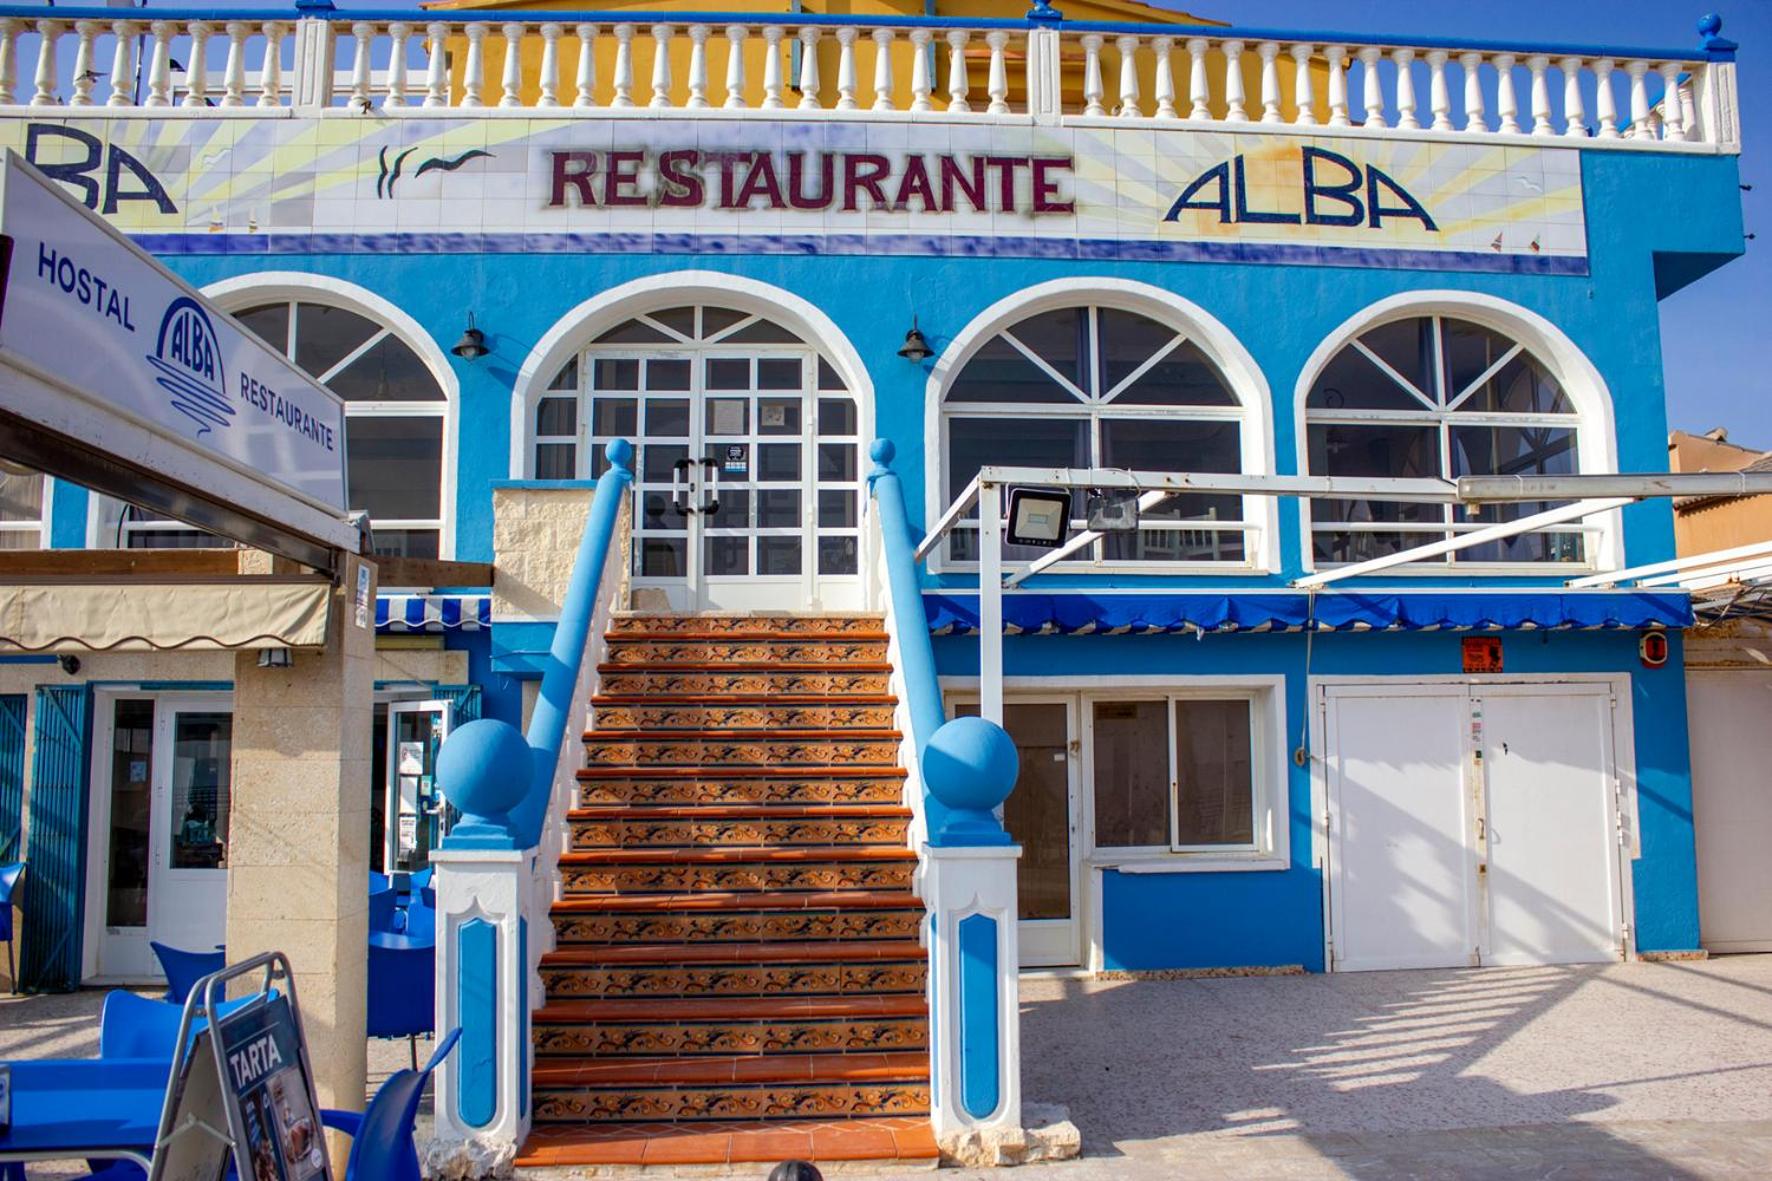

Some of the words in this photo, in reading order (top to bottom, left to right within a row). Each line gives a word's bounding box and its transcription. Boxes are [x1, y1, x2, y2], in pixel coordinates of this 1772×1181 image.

[548, 150, 1076, 216] RESTAURANTE
[1162, 145, 1440, 231] ALBA
[38, 242, 135, 331] HOSTAL
[171, 311, 214, 381] ALBA
[241, 371, 333, 450] RESTAURANTE
[230, 1033, 282, 1088] TARTA
